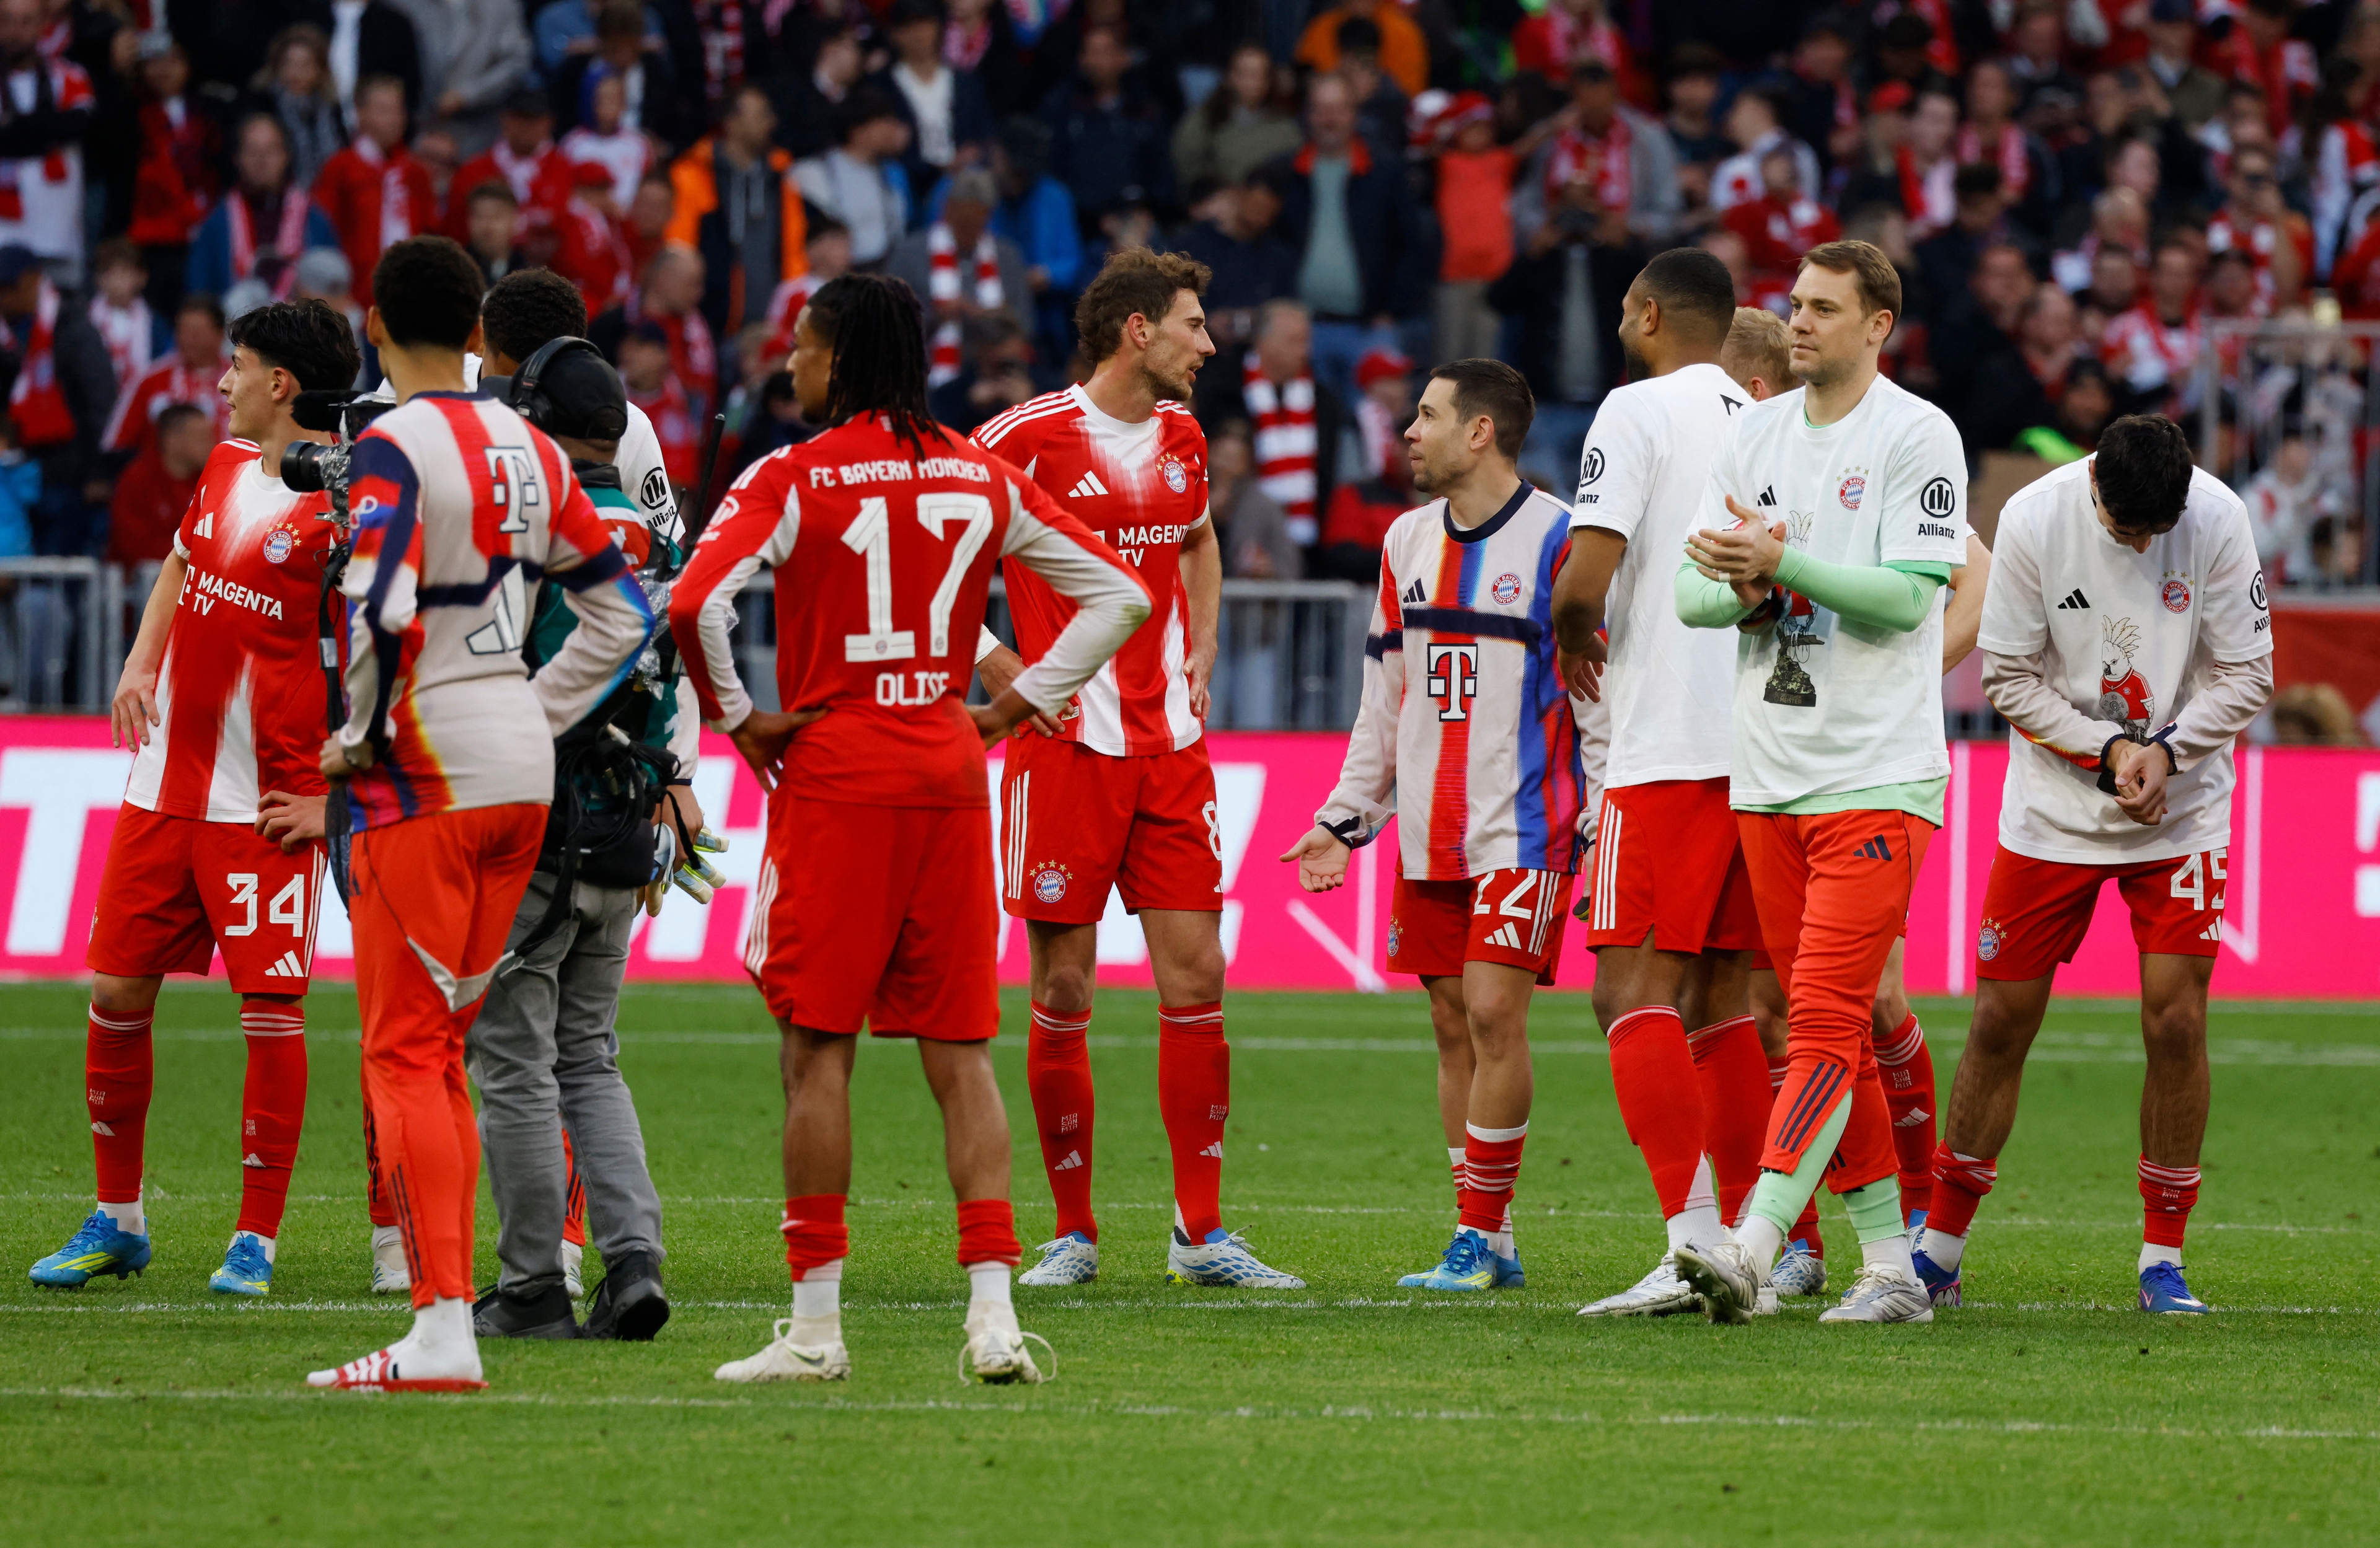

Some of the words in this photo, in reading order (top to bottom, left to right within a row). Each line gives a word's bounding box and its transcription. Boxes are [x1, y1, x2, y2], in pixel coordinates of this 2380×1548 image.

[809, 467, 836, 489] FC
[839, 459, 913, 485] BAYERN
[916, 457, 990, 483] MÜNCHEN
[1842, 481, 1849, 491] FC
[1849, 479, 1866, 489] BAYER
[278, 534, 291, 549] BAYERN
[1118, 524, 1189, 547] MAGENT
[1918, 524, 1955, 540] Allianz
[1118, 548, 1144, 567] TV
[840, 493, 994, 662] 17
[1502, 575, 1520, 588] BAYERN
[198, 571, 283, 621] MAGENTA
[2164, 586, 2171, 595] FC
[193, 592, 215, 616] TV
[876, 671, 950, 706] OLISE
[1427, 643, 1478, 722] T
[1202, 801, 1222, 861] 8
[1038, 876, 1044, 884] FC
[1044, 873, 1064, 886] BAYERN
[2171, 848, 2228, 911] 45
[225, 873, 304, 937] 34
[1473, 868, 1532, 920] 22
[1061, 1113, 1078, 1122] MIA
[1061, 1124, 1078, 1133] MIA
